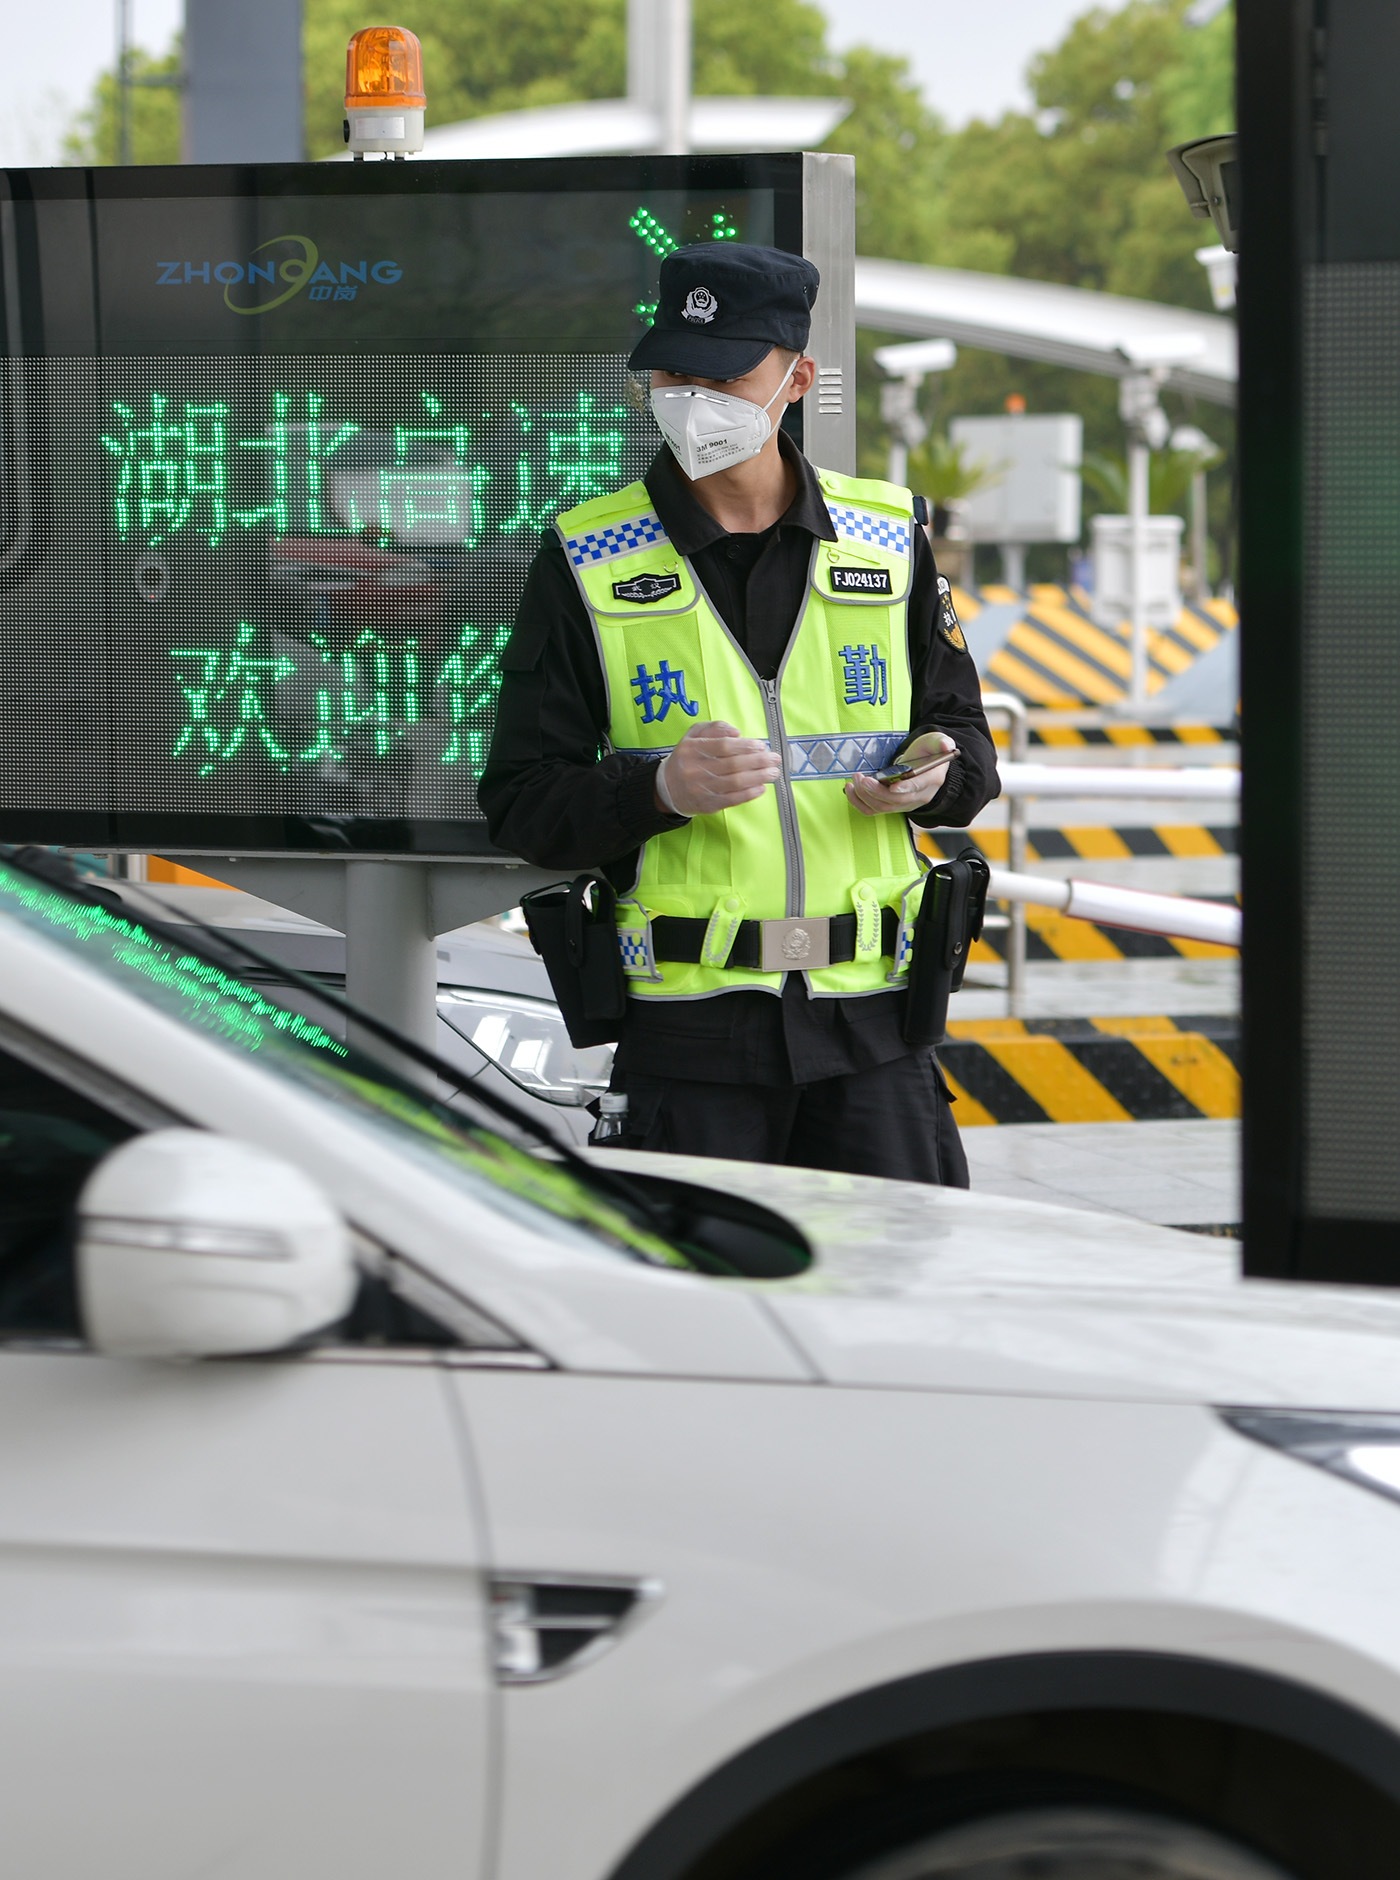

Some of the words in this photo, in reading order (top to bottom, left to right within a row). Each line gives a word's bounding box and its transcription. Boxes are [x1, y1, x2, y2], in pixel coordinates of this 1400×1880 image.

[308, 285, 359, 302] 中岗
[696, 443, 708, 453] 3M
[709, 439, 728, 449] 9001
[101, 391, 628, 548] 湖北高速
[833, 571, 888, 589] FJ024137
[630, 660, 699, 724] 执
[838, 644, 886, 706] 勤
